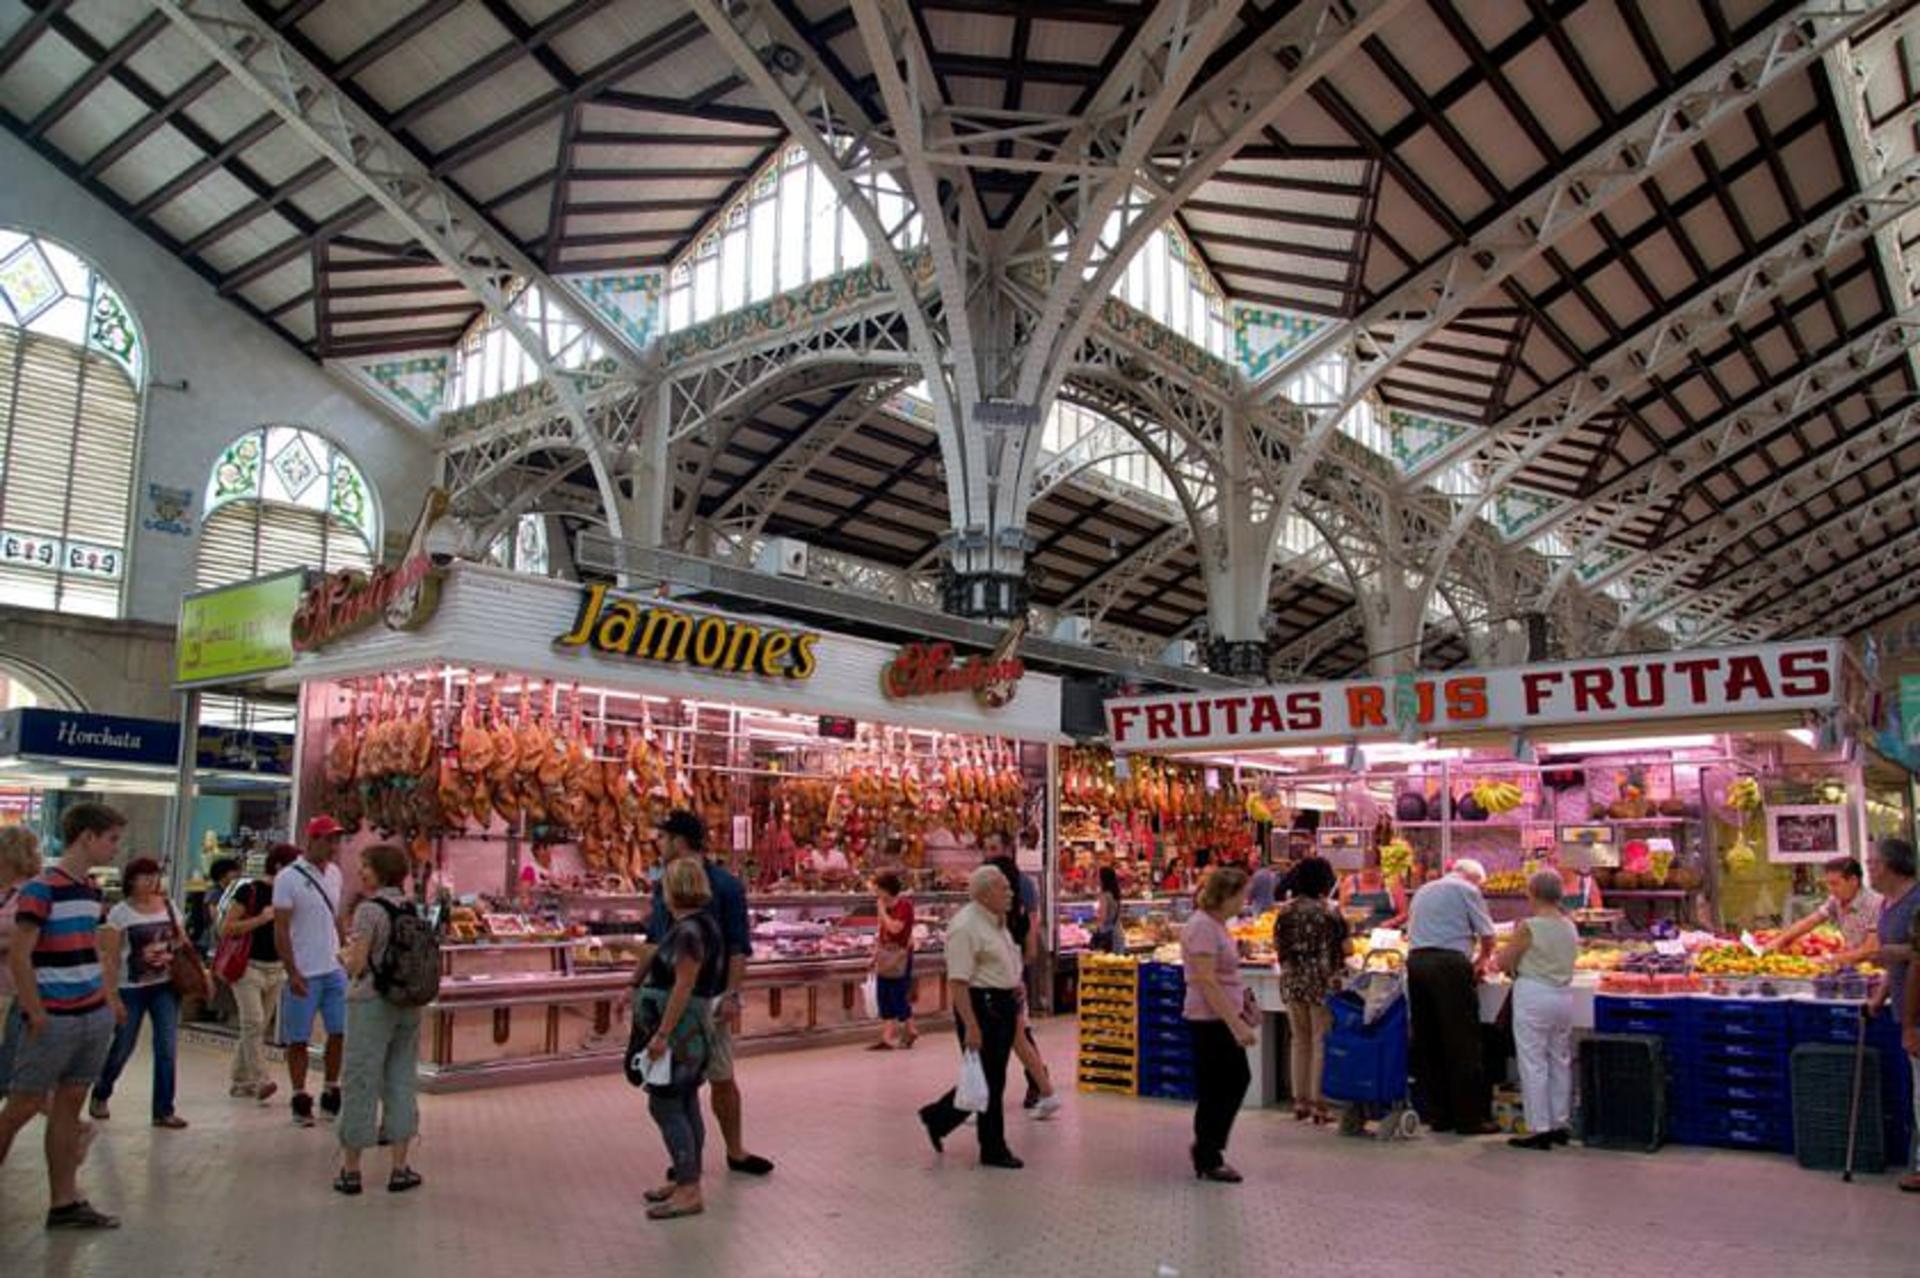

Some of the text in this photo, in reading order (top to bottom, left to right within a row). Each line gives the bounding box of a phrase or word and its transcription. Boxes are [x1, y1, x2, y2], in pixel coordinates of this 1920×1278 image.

[561, 583, 819, 680] Jamones
[57, 721, 142, 750] Horchata
[1111, 692, 1322, 742] FRUTAS
[1522, 650, 1830, 714] FRUTAS
